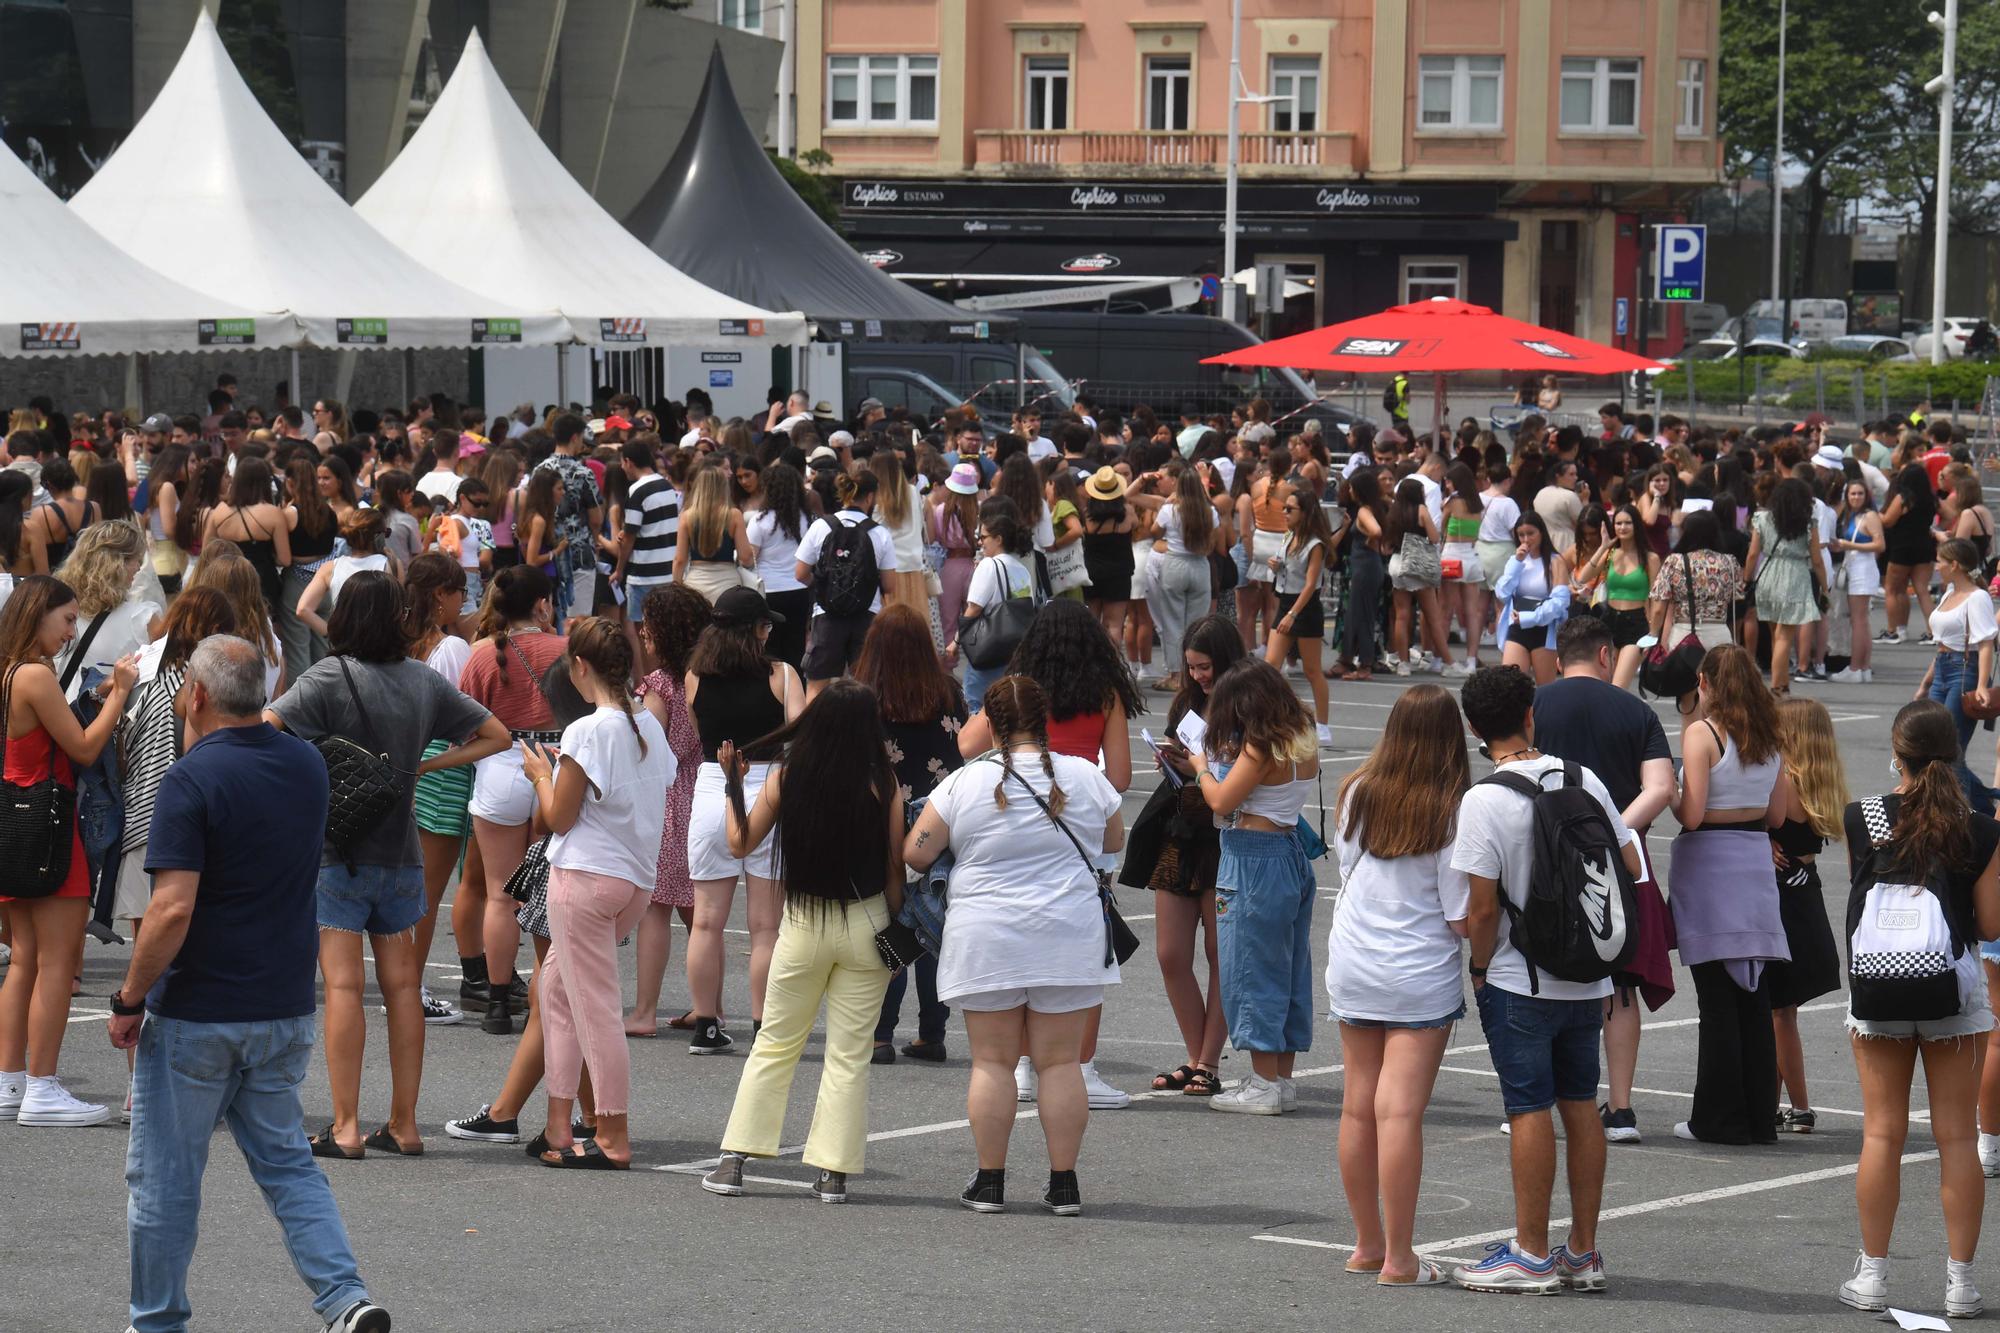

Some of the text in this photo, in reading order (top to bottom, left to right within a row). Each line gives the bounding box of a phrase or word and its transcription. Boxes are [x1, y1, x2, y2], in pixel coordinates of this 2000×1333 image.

[853, 184, 944, 207] Caprice ESTADIO
[1071, 186, 1165, 210] Caprice ESTADIO
[1316, 188, 1420, 212] Caprice ESTADIO
[1663, 228, 1701, 278] P
[1666, 287, 1692, 299] LIBRE
[1578, 852, 1611, 934] NIKE
[1880, 912, 1918, 927] VANS
